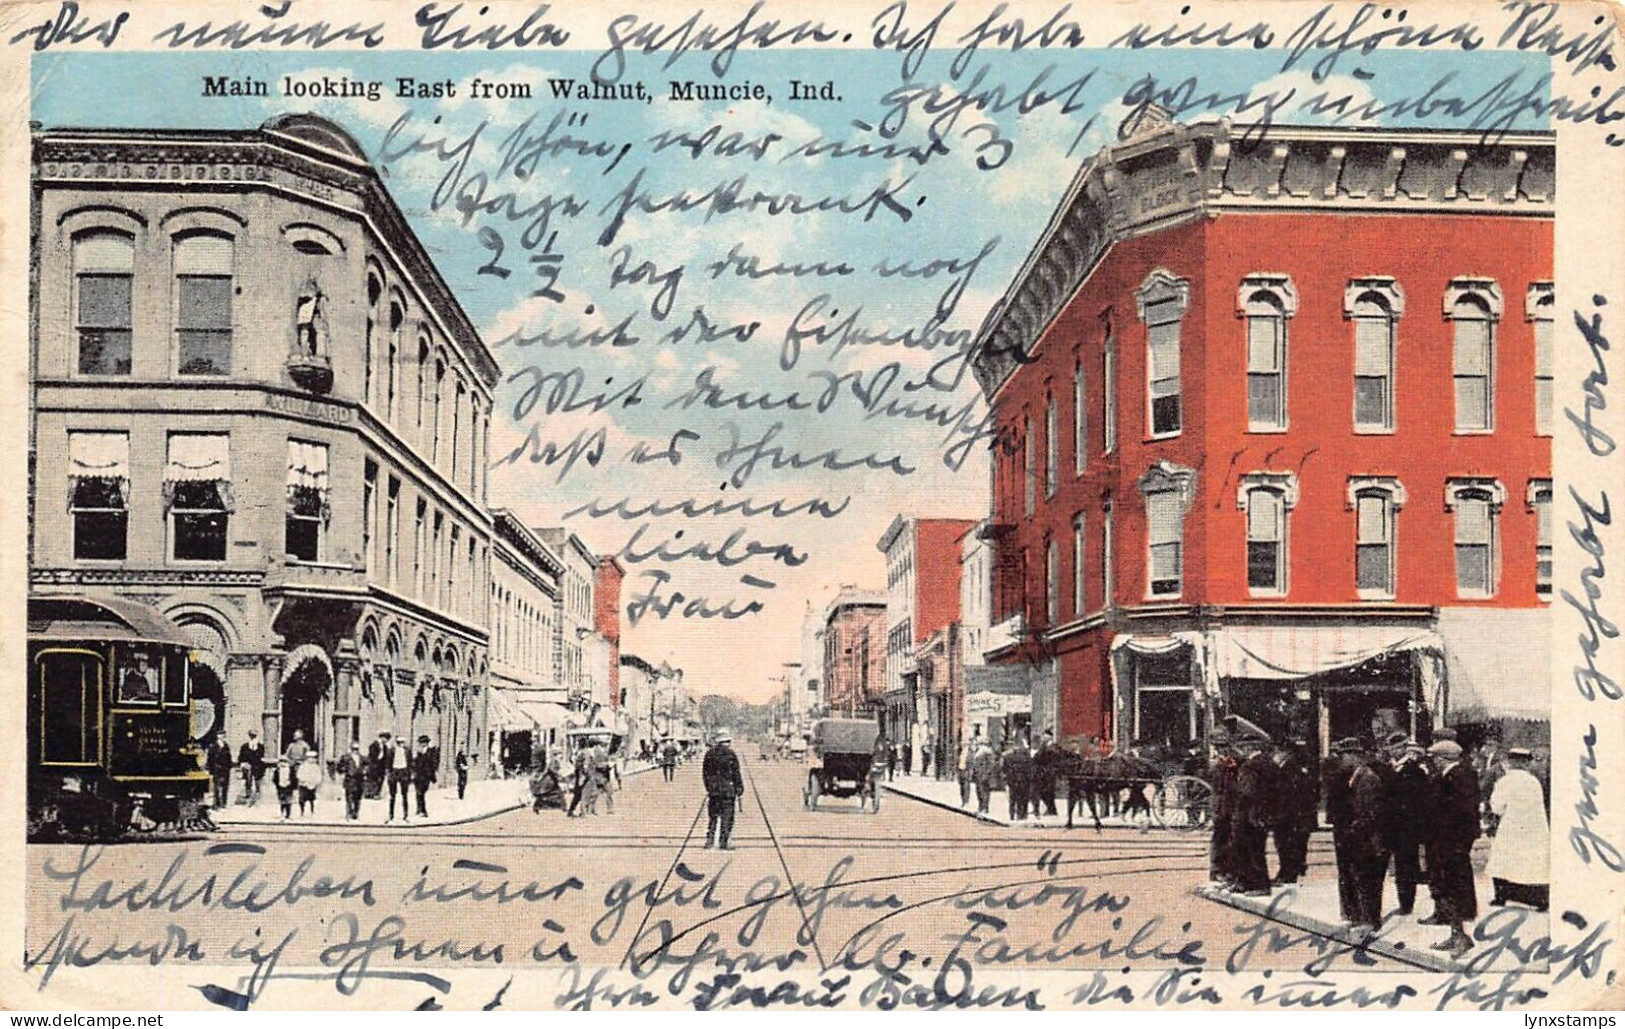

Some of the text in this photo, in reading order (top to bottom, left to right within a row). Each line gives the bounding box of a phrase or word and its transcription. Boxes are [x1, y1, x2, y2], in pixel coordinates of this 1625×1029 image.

[202, 75, 843, 101] Main looking East from Walnut, Muncie, Ind.
[961, 122, 1014, 171] 3
[476, 225, 512, 280] 2
